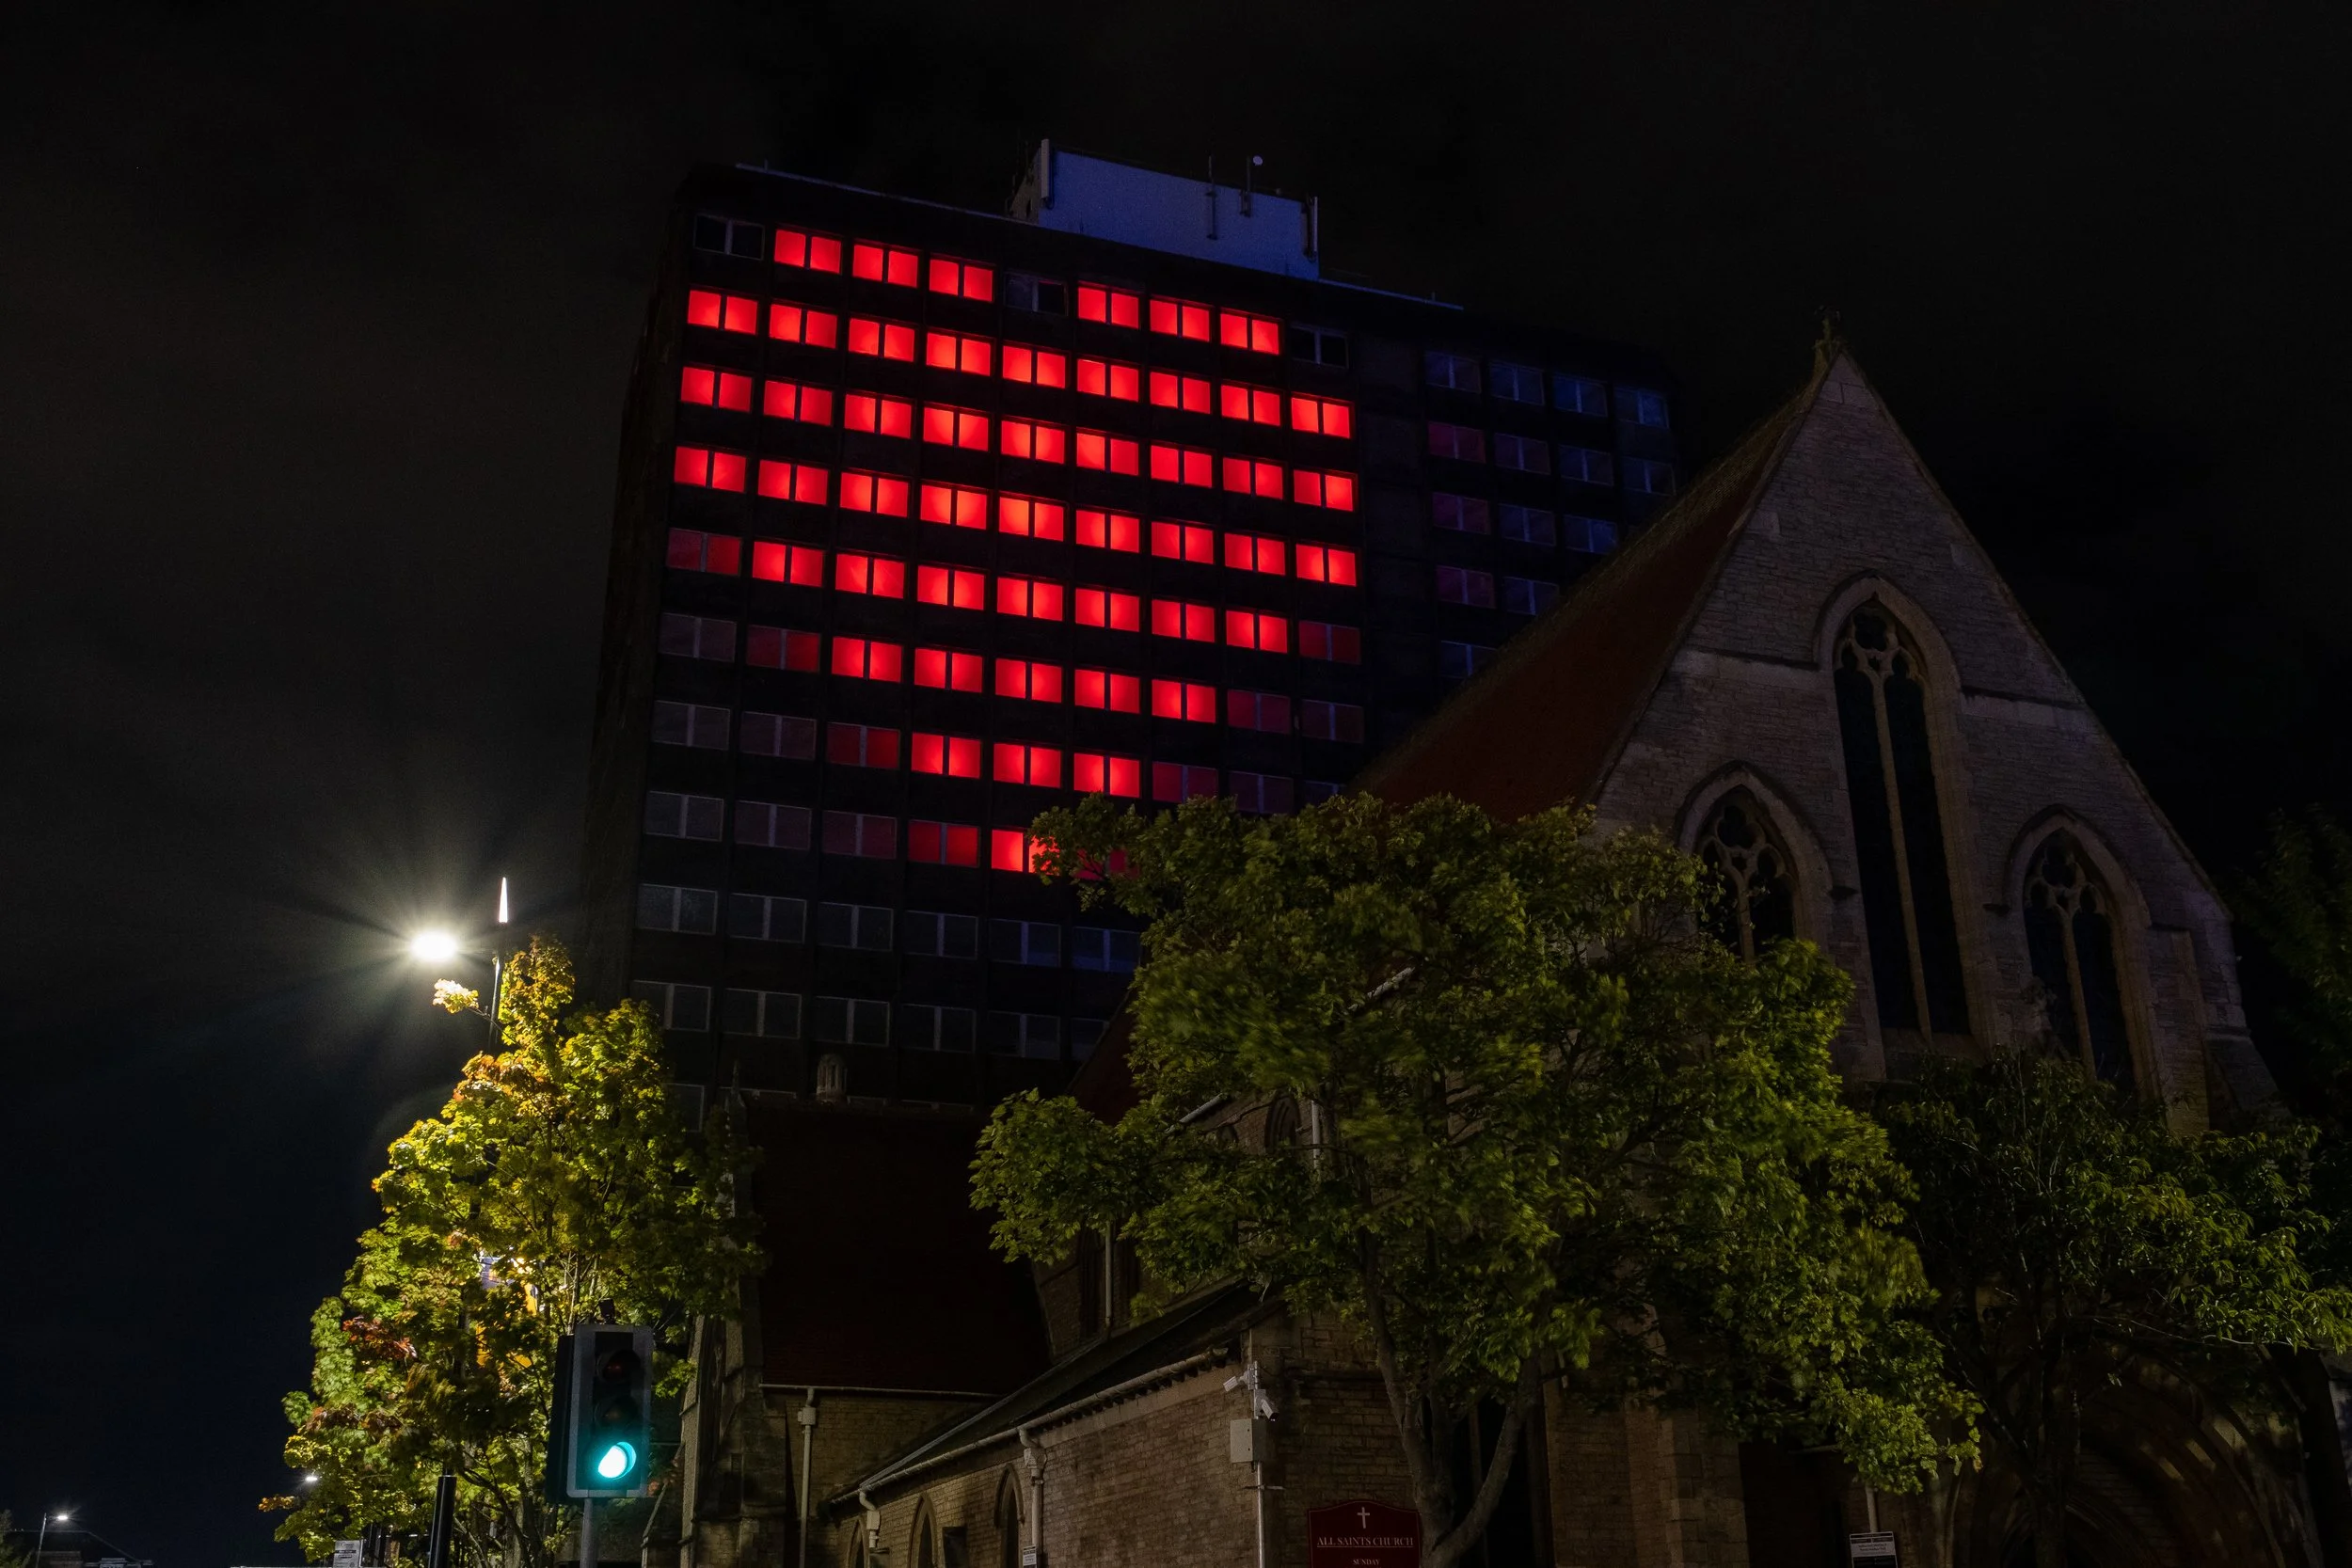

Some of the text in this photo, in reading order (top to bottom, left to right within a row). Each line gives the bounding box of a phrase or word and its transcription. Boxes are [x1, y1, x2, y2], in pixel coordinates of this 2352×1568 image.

[1317, 1536, 1414, 1545] ALL SAINTS CHURCH
